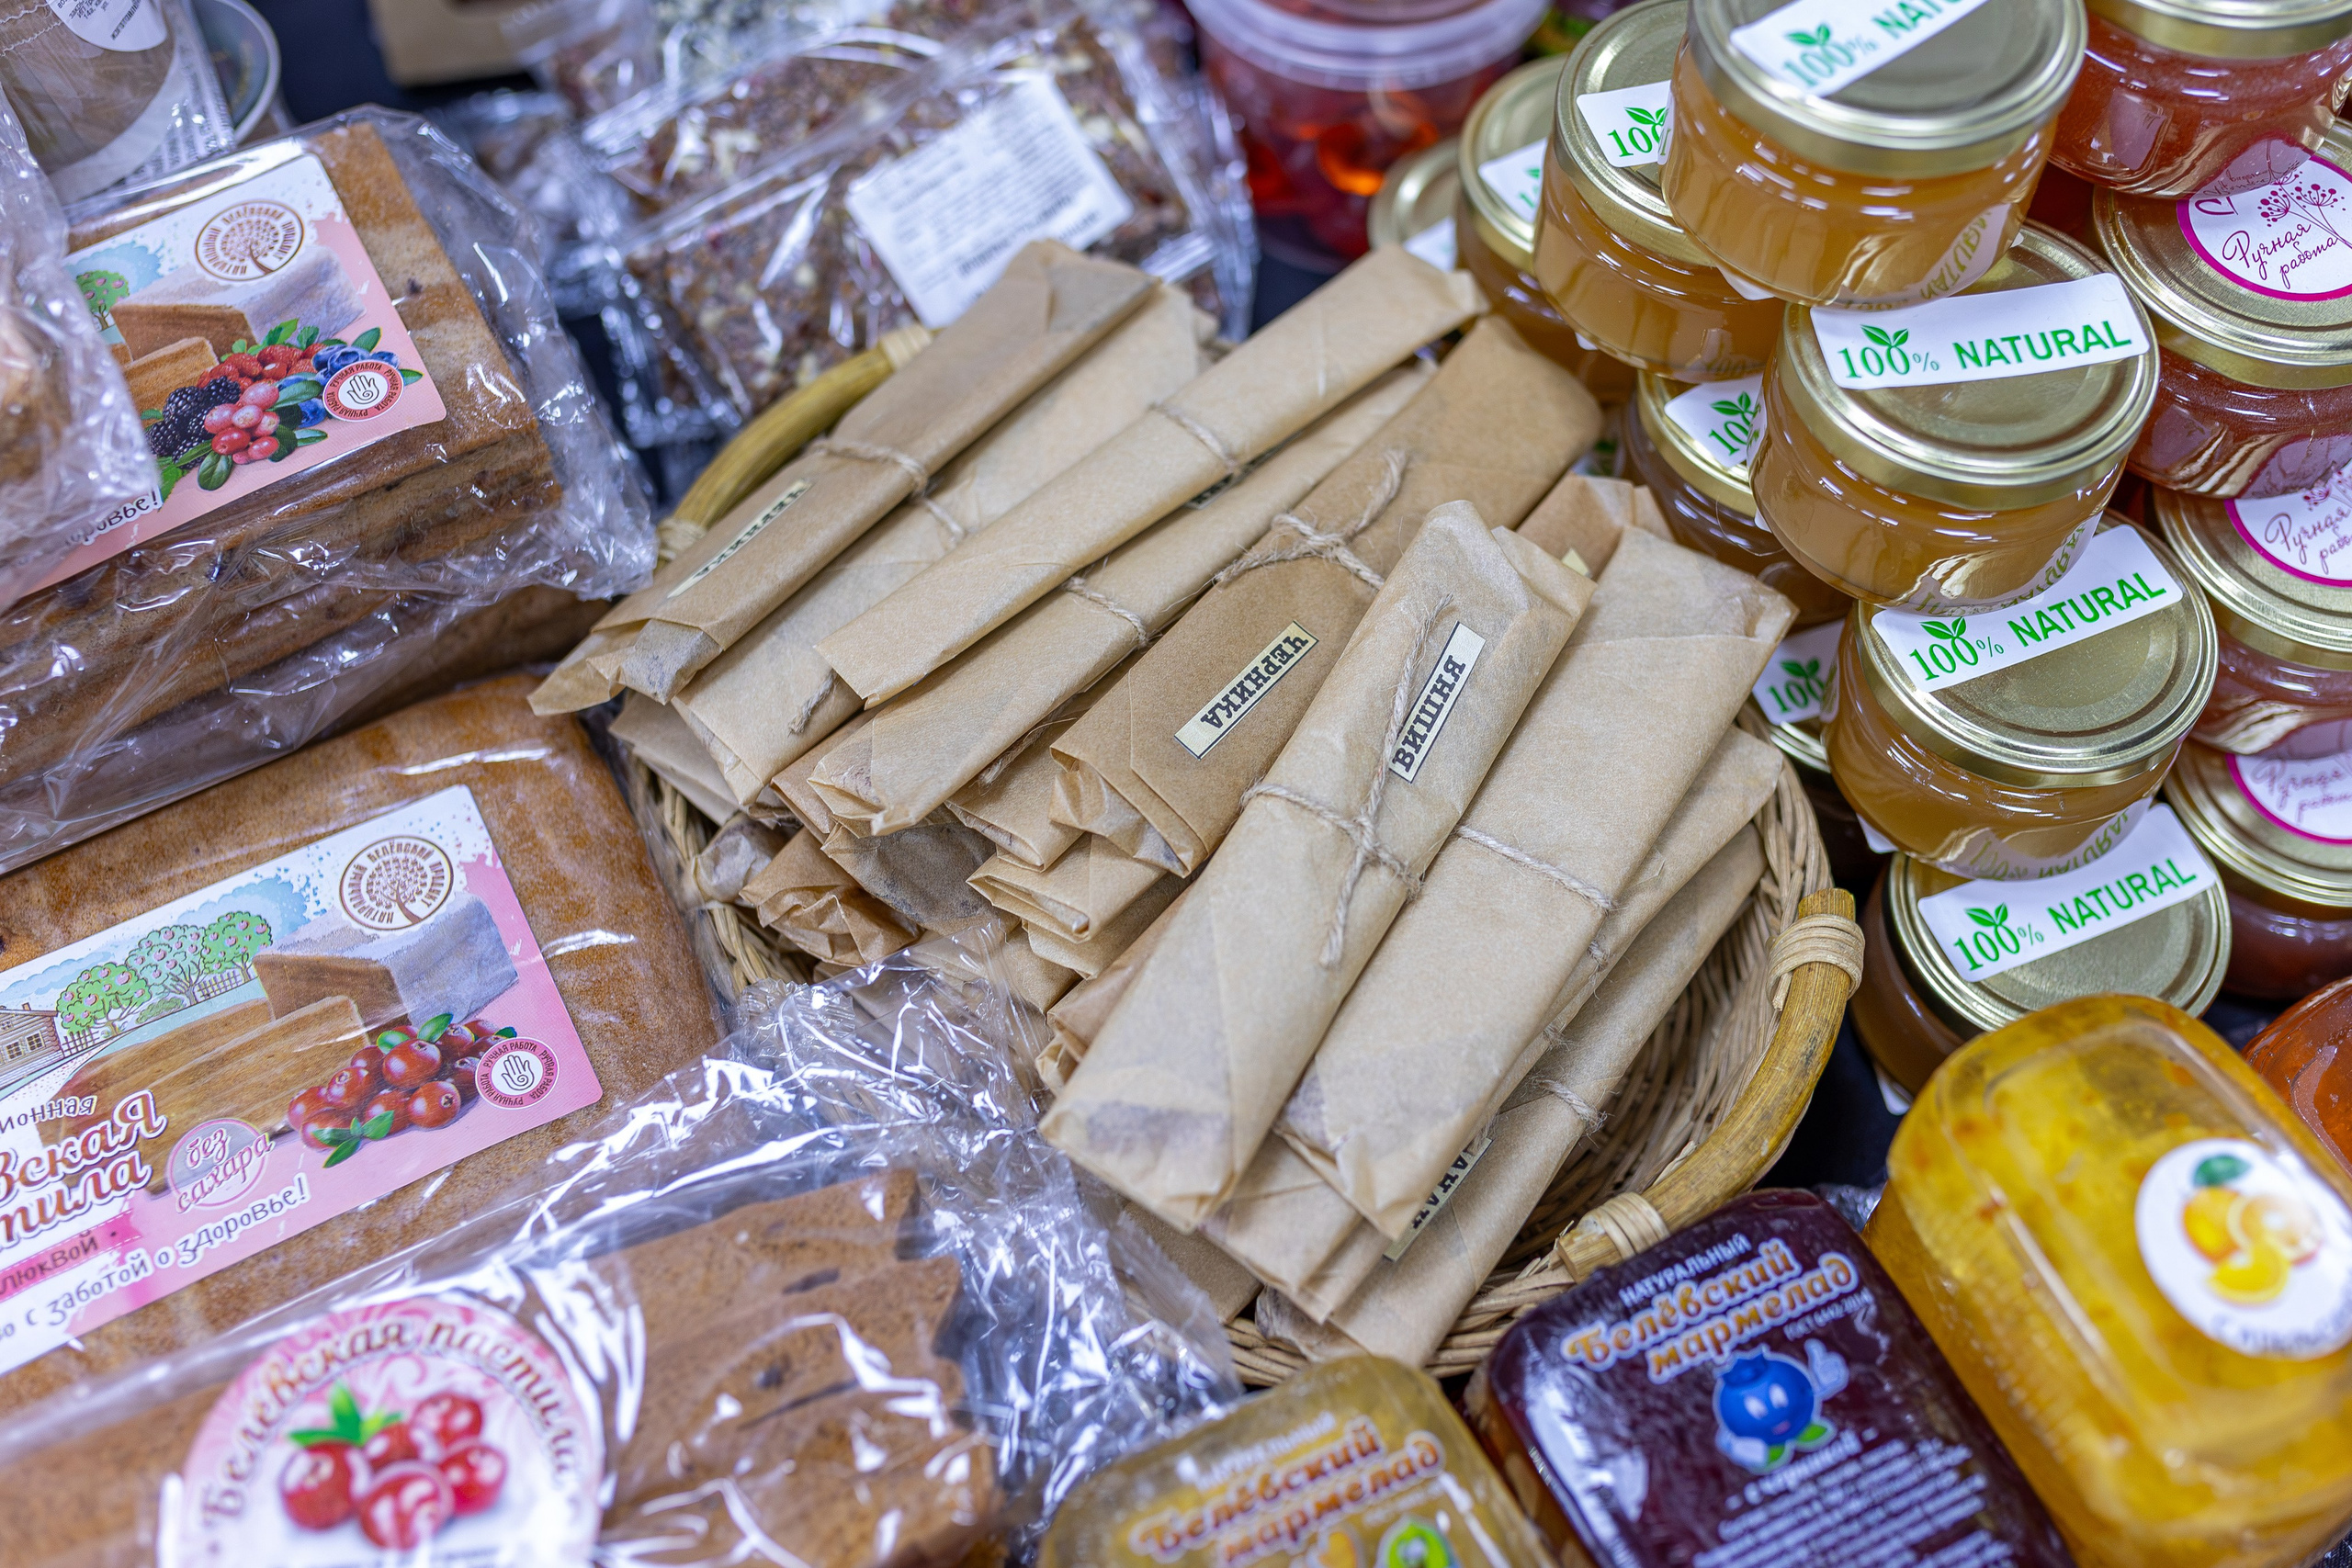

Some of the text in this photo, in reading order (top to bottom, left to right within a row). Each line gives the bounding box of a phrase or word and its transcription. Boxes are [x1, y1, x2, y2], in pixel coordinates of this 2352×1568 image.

[2222, 223, 2312, 281] Ручная
[2279, 240, 2339, 290] работа
[1838, 320, 2132, 379] 100% NATURAL
[1909, 571, 2167, 682] 100% NATURAL
[1200, 635, 1309, 729] ЧЕРНИКА
[1393, 654, 1467, 773] ВИШНЯ
[1953, 922, 2045, 972] 100%
[2047, 857, 2198, 935] NATURAL
[480, 1041, 555, 1106] РУЧНАЯ РАБОТА РУЧНАЯ РАБОТА РУЧНАЯ РАБОТА
[175, 1134, 273, 1213] сахара
[187, 1127, 229, 1168] без
[46, 1253, 149, 1326] заботой
[158, 1250, 170, 1266] о
[1564, 1241, 1798, 1369] Белёвский
[1618, 1232, 1753, 1309] НАТУРАЛЬНЫЙ
[1652, 1255, 1854, 1380] мармелад
[1223, 1437, 1442, 1565] мармелад
